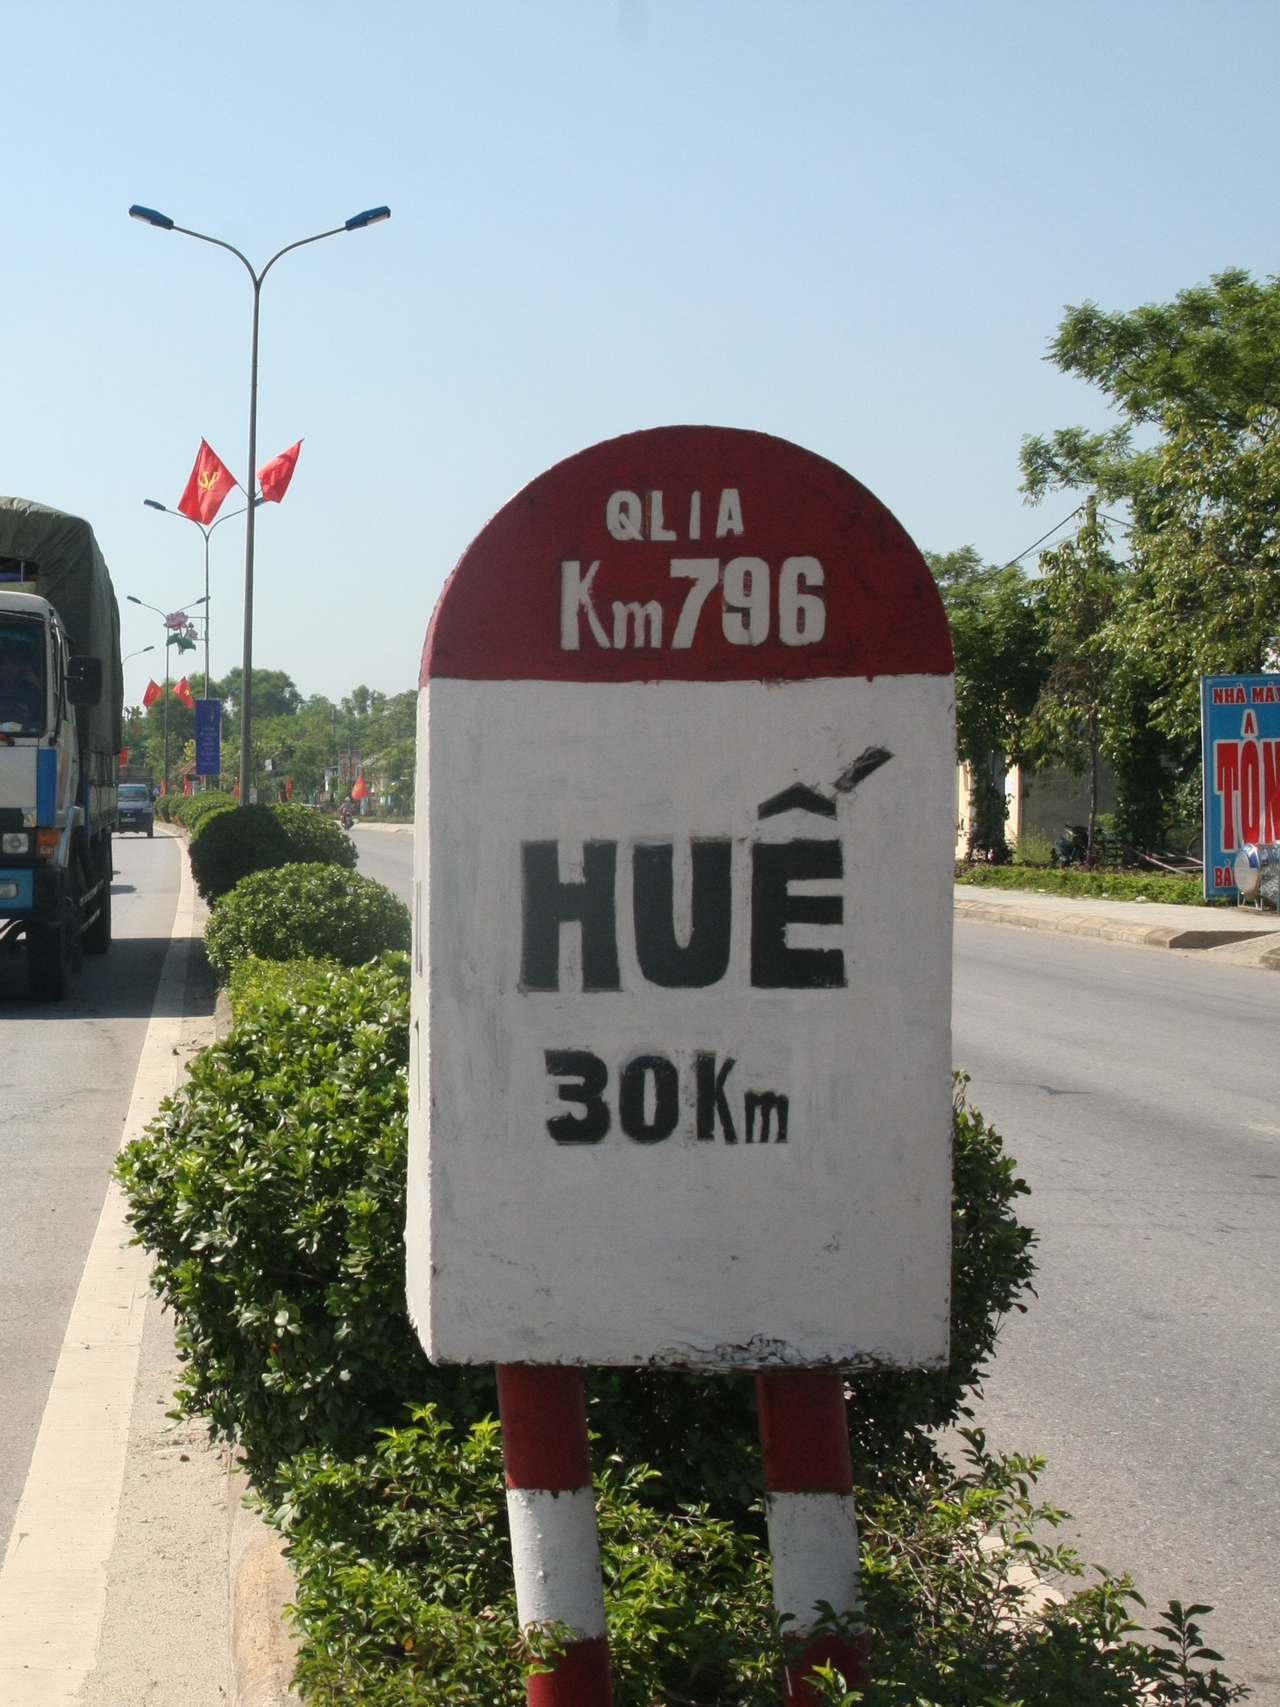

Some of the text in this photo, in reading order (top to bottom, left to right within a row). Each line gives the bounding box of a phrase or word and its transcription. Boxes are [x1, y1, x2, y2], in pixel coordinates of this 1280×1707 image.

[560, 556, 827, 651] Km796
[1213, 682, 1246, 704] NHÀ
[520, 745, 895, 992] HUẾ
[1215, 859, 1237, 886] BẢ
[543, 1048, 790, 1146] 30Km
